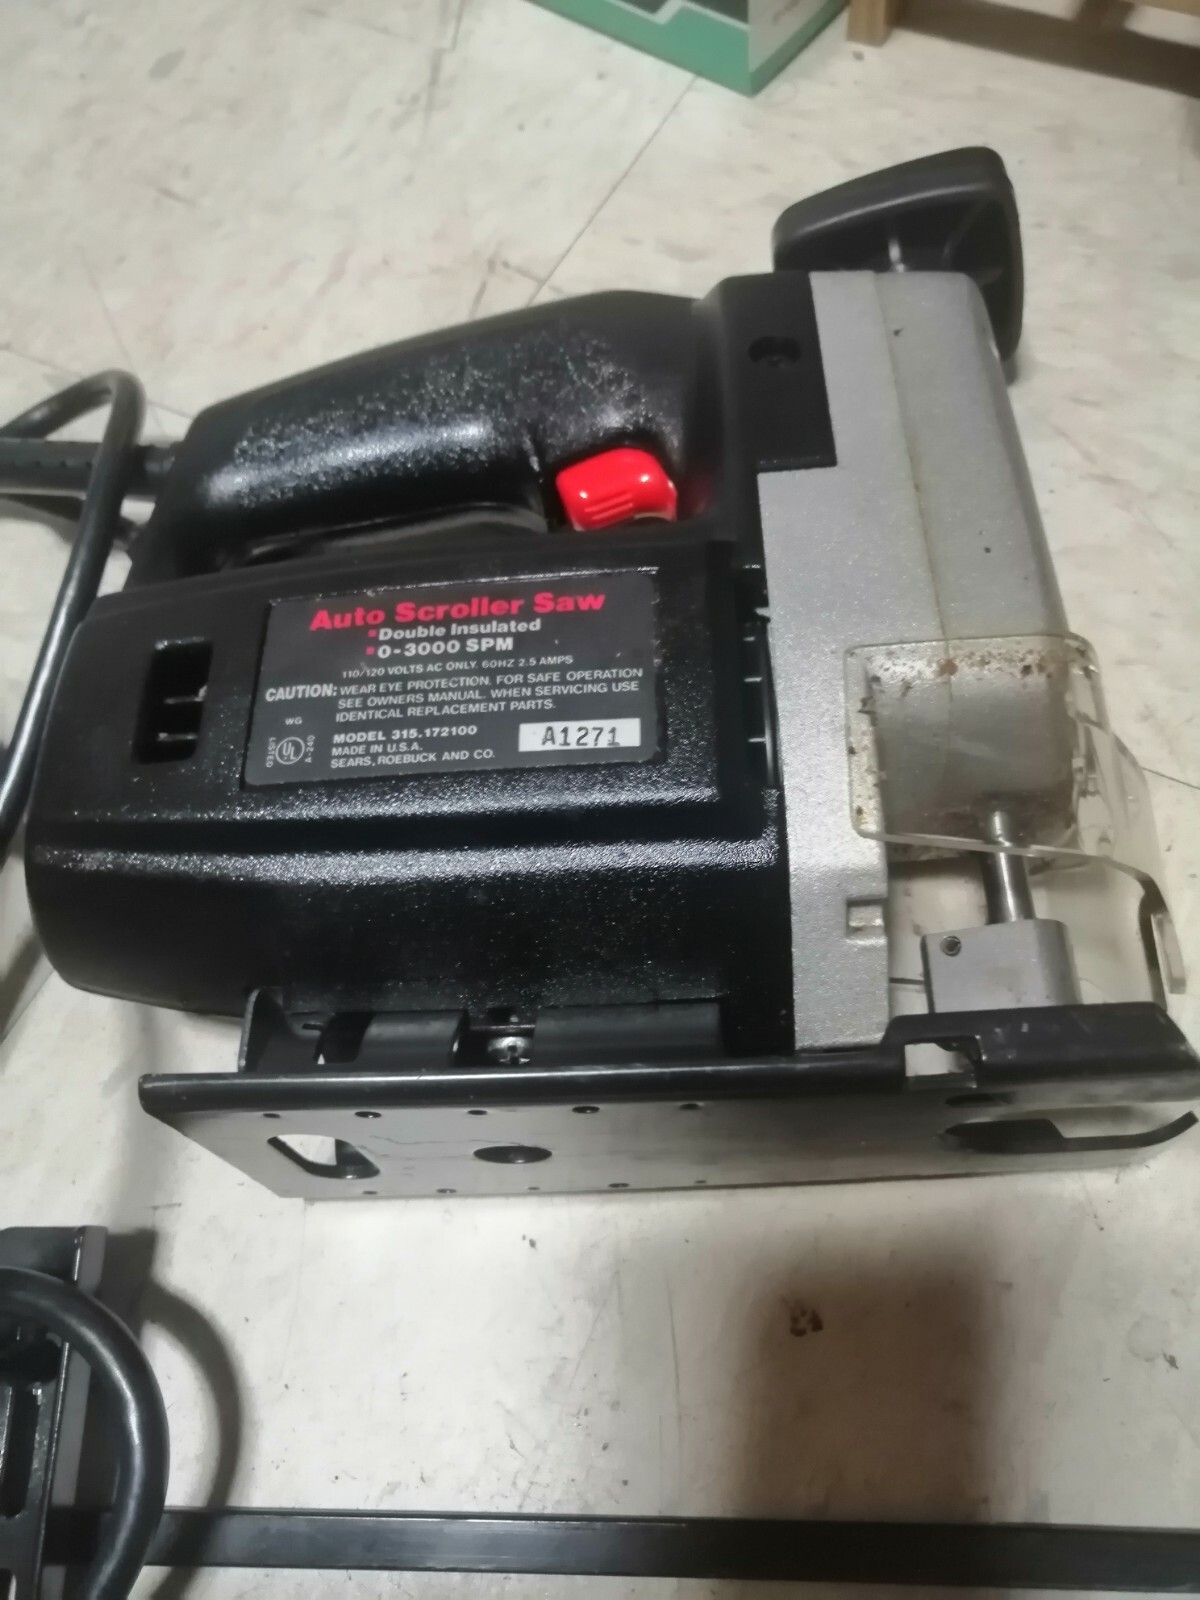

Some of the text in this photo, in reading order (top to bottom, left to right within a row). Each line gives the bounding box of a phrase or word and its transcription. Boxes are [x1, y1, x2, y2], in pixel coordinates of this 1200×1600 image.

[310, 591, 606, 631] Auto Scroller Saw
[378, 617, 542, 641] Double Insulated
[377, 636, 514, 660] 0-3000 SPM
[342, 665, 385, 679] 110/120
[387, 663, 424, 676] VOLTS
[426, 662, 443, 673] AC
[481, 658, 515, 669] 60HZ
[518, 657, 537, 667] 2.5
[539, 654, 574, 666] AMPS
[265, 682, 338, 702] CAUTION:
[340, 682, 376, 696] WEAR
[379, 681, 403, 693] EYE
[496, 673, 524, 686] FOR
[527, 671, 561, 684] SAFE
[565, 667, 643, 682] OPERATION
[337, 697, 363, 710] SEE
[366, 693, 425, 708] OWNERS
[490, 686, 532, 699] WHEN
[535, 682, 608, 697] SERVICING
[611, 681, 640, 693] USE
[284, 716, 303, 726] WG
[335, 698, 556, 723] IDENTICAL REPLACEMENT PARTS.
[332, 724, 478, 745] MODEL 315.172100
[541, 725, 621, 748] A1271
[331, 741, 423, 757] MADE IN U.S.A.
[377, 751, 437, 766] ROEBUCK
[442, 750, 470, 761] AND
[473, 748, 496, 760] CO.
